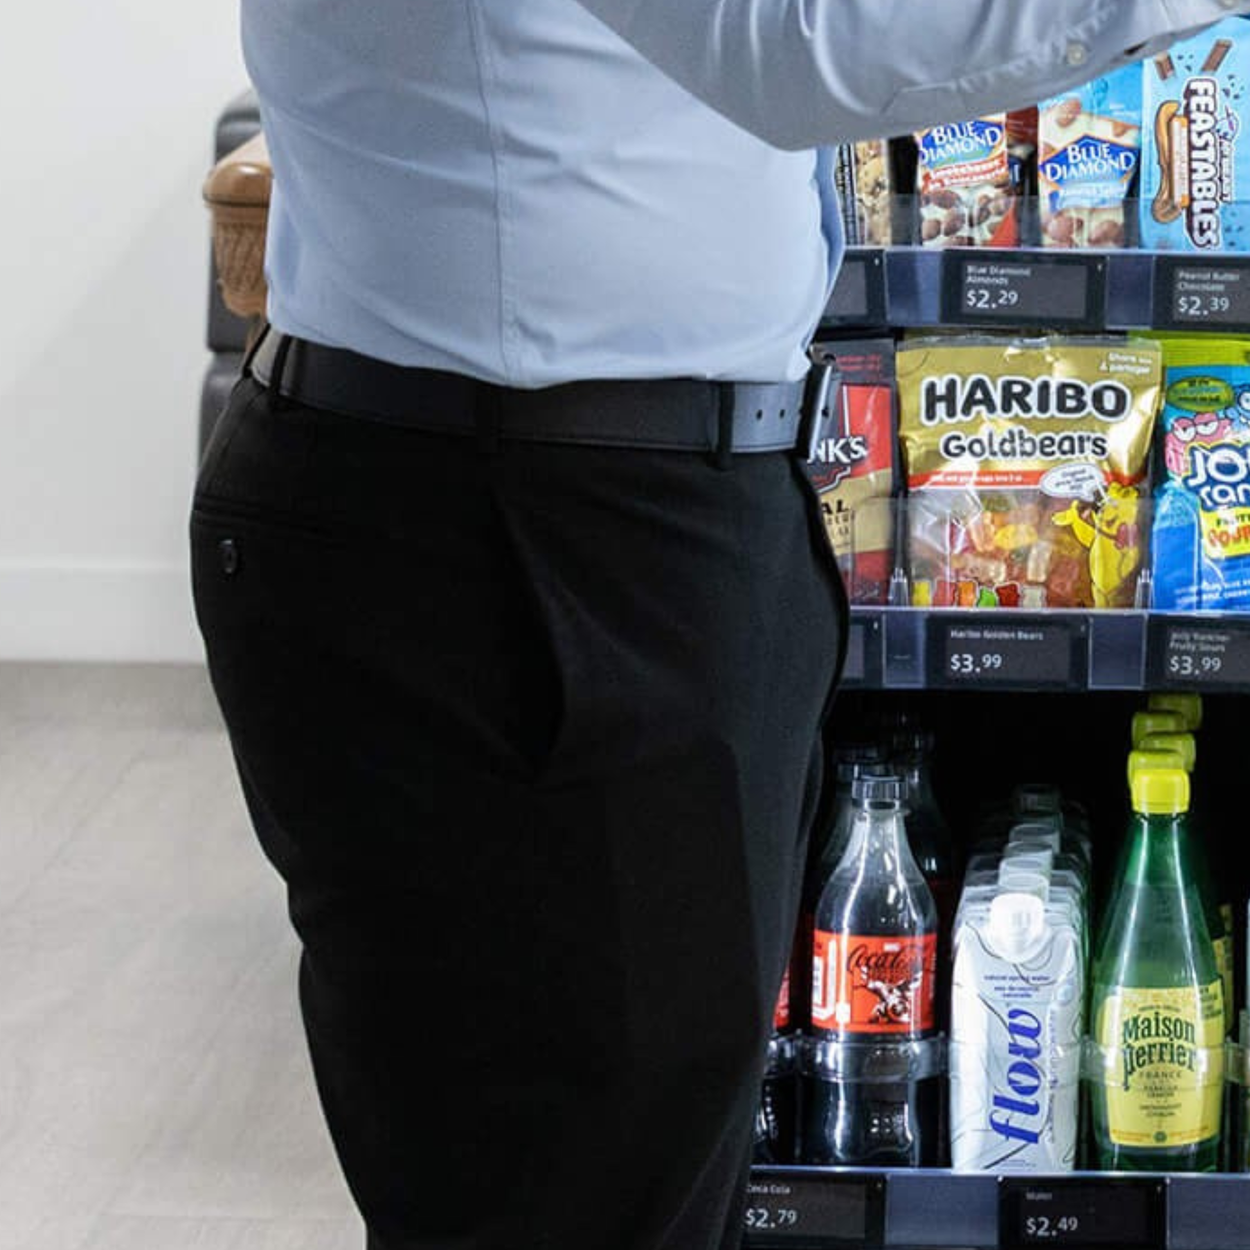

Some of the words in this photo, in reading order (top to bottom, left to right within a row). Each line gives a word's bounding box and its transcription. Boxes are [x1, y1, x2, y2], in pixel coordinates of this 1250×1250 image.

[933, 121, 976, 145] BLUE
[920, 126, 1001, 165] DIAMOND
[1067, 143, 1111, 164] BLUE
[1045, 151, 1135, 181] DIAMOND
[1187, 79, 1220, 248] FEASTABLES
[966, 289, 1018, 309] $2.29
[1178, 296, 1230, 316] $2.39
[923, 376, 1129, 423] HARIBO
[942, 428, 1108, 458] Goldbears
[950, 654, 1002, 673] $3.99
[1170, 655, 1222, 675] $3.99
[1123, 1011, 1196, 1045] Maison
[989, 1008, 1042, 1145] flow
[745, 1208, 797, 1228] $2.79
[1026, 1216, 1078, 1237] $2.49
